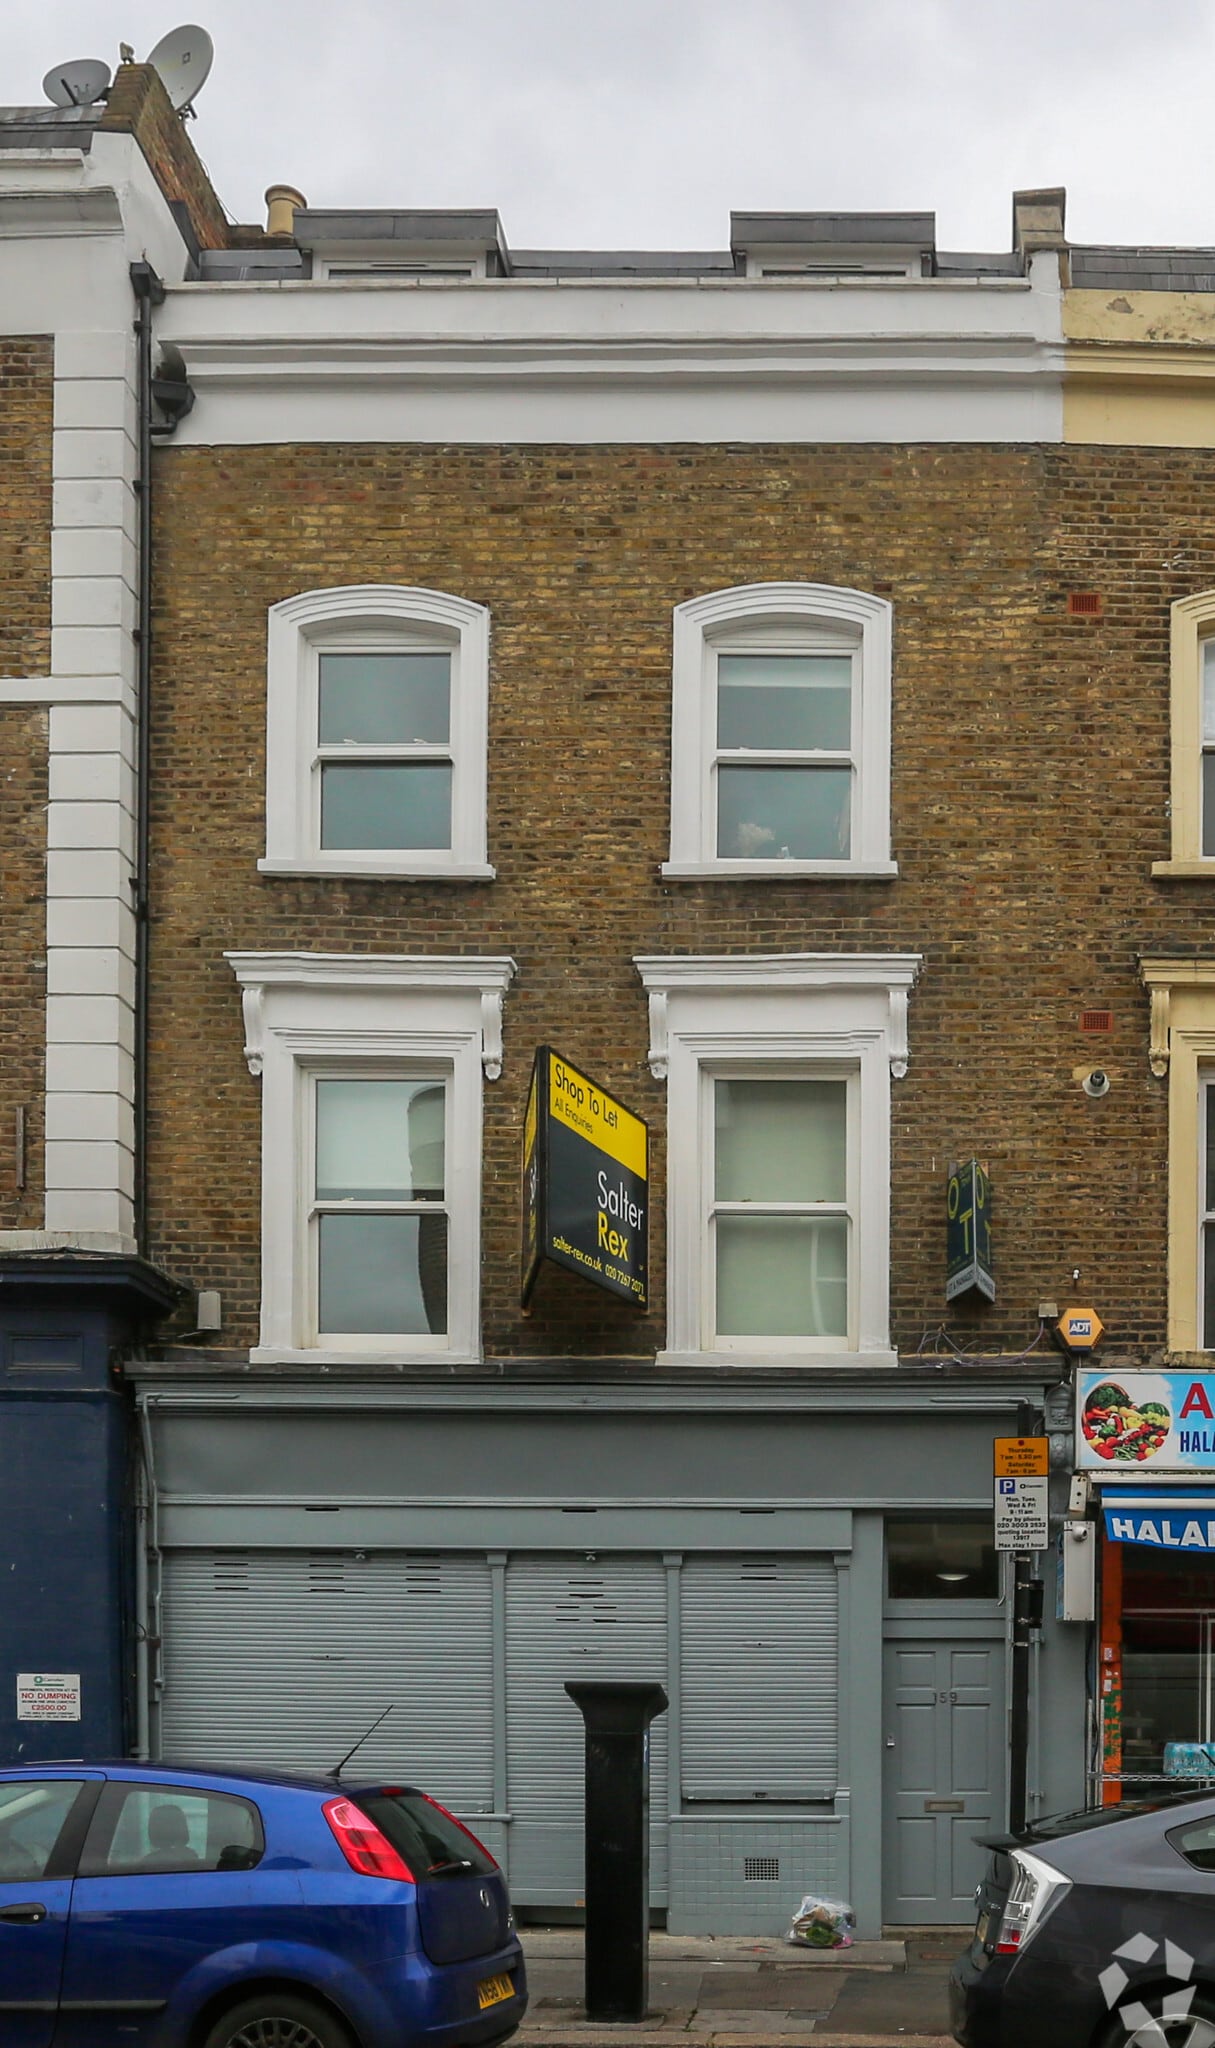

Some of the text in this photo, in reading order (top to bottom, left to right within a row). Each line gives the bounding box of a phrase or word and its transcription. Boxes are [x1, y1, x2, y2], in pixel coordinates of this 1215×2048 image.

[555, 1063, 618, 1131] Shop To Let
[555, 1097, 593, 1134] All Enquiries
[597, 1170, 644, 1231] Salter
[597, 1210, 629, 1262] Rex
[552, 1235, 602, 1272] salter-rex.co.uk
[604, 1263, 617, 1280] 020
[1069, 1322, 1091, 1333] ADT
[1179, 1382, 1214, 1419] A
[1003, 1480, 1014, 1493] P
[21, 1692, 77, 1700] NO DUMPING
[932, 1691, 957, 1704] 159
